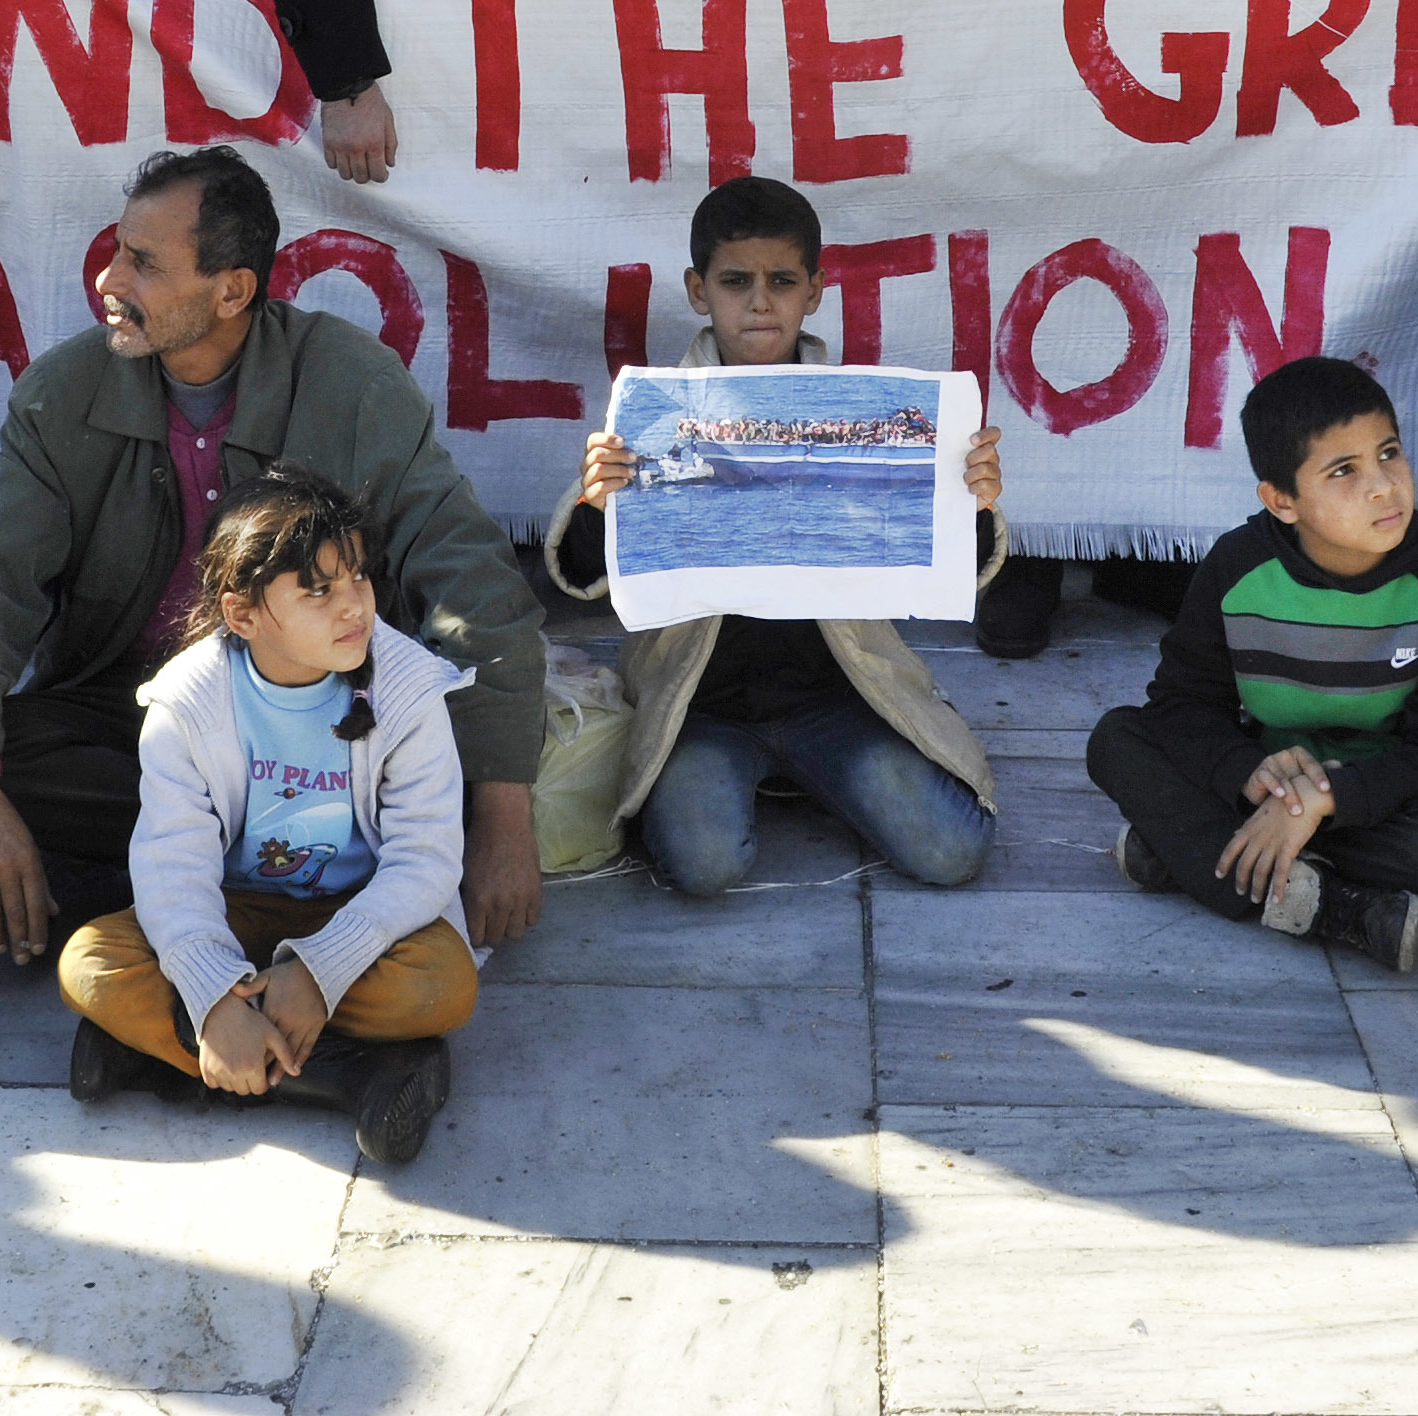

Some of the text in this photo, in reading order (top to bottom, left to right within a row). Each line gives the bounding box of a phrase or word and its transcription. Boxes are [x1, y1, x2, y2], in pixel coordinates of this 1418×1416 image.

[1396, 647, 1418, 660] NIKE
[252, 759, 348, 792] OY PLAN
